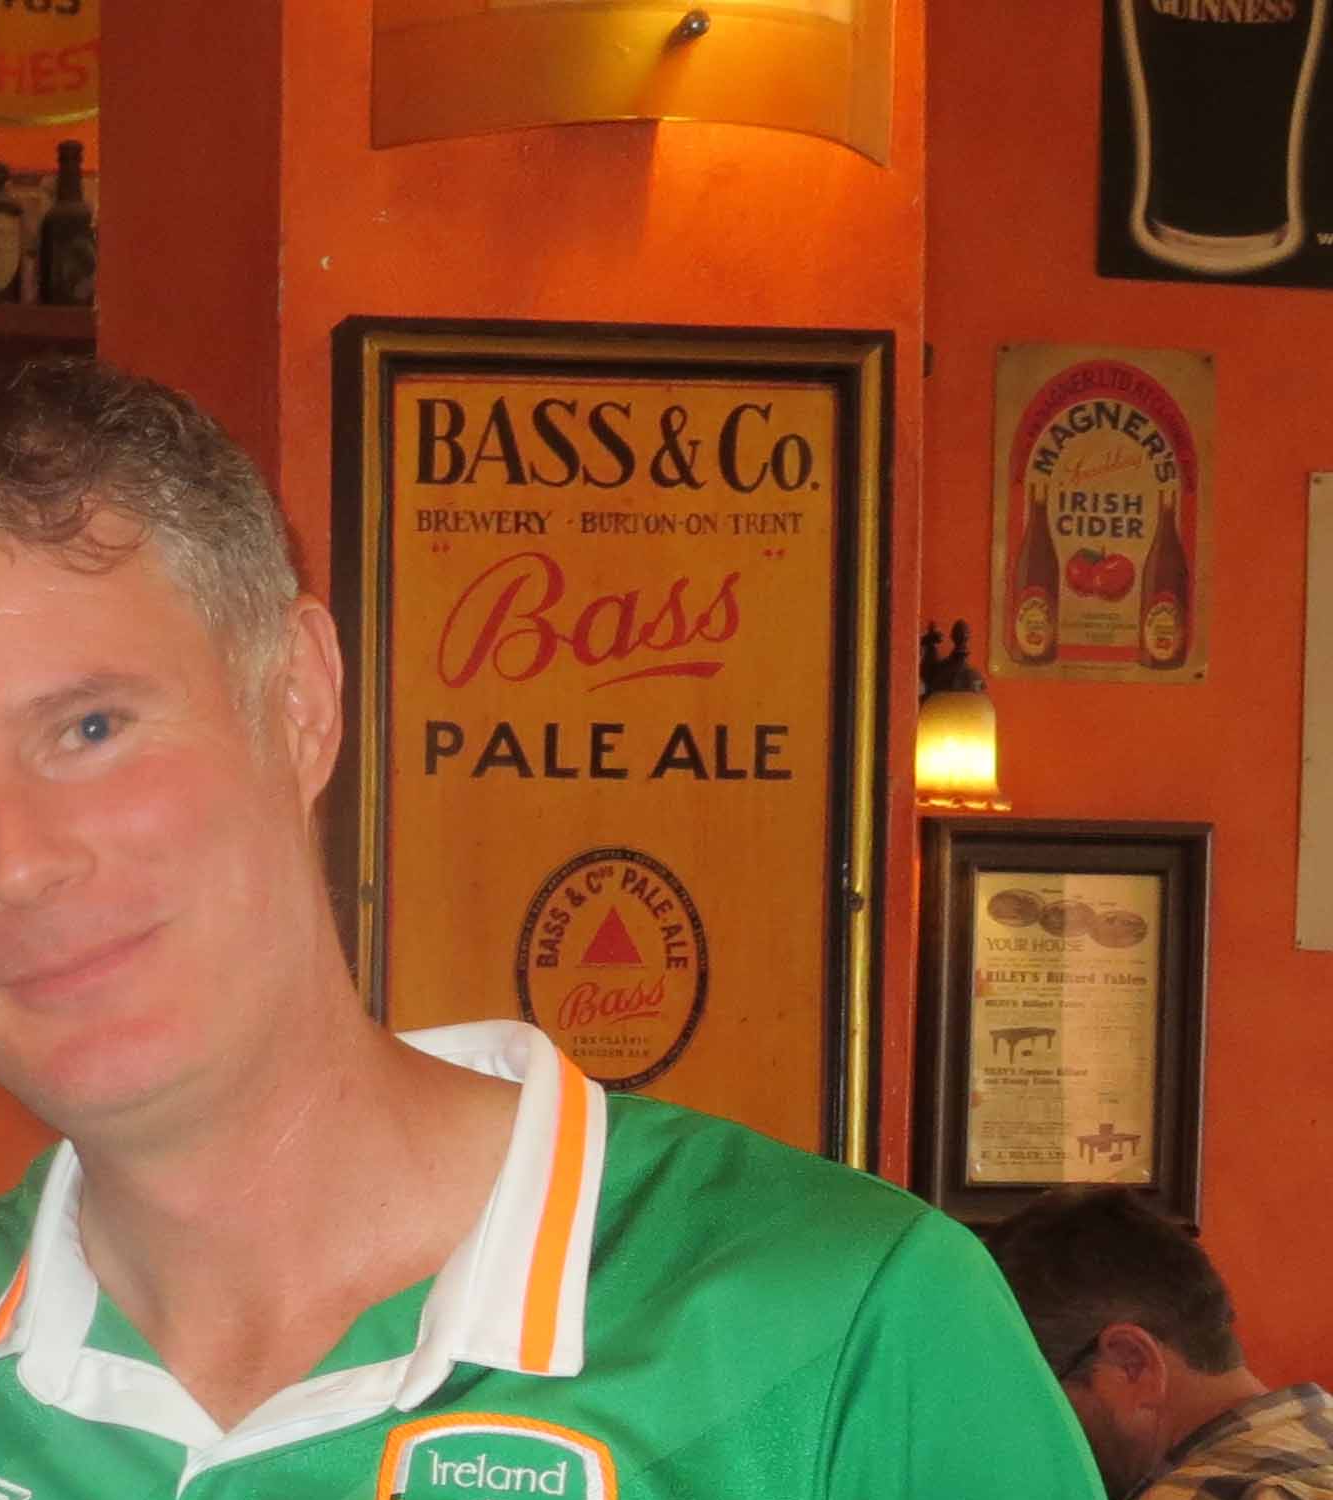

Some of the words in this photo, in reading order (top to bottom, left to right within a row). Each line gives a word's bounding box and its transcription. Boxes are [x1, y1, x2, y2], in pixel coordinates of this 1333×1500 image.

[415, 396, 636, 489] BASS
[650, 404, 708, 492] &
[1033, 400, 1178, 484] MAGNER'S
[416, 508, 553, 536] BREWERY
[1055, 514, 1145, 539] CIDER
[1058, 491, 1143, 516] IRISH
[424, 720, 630, 779] PALE
[648, 722, 794, 781] ALE
[535, 907, 572, 969] BASS
[620, 866, 674, 920] PALE
[660, 922, 688, 971] ALE
[428, 1446, 568, 1499] Ireland
